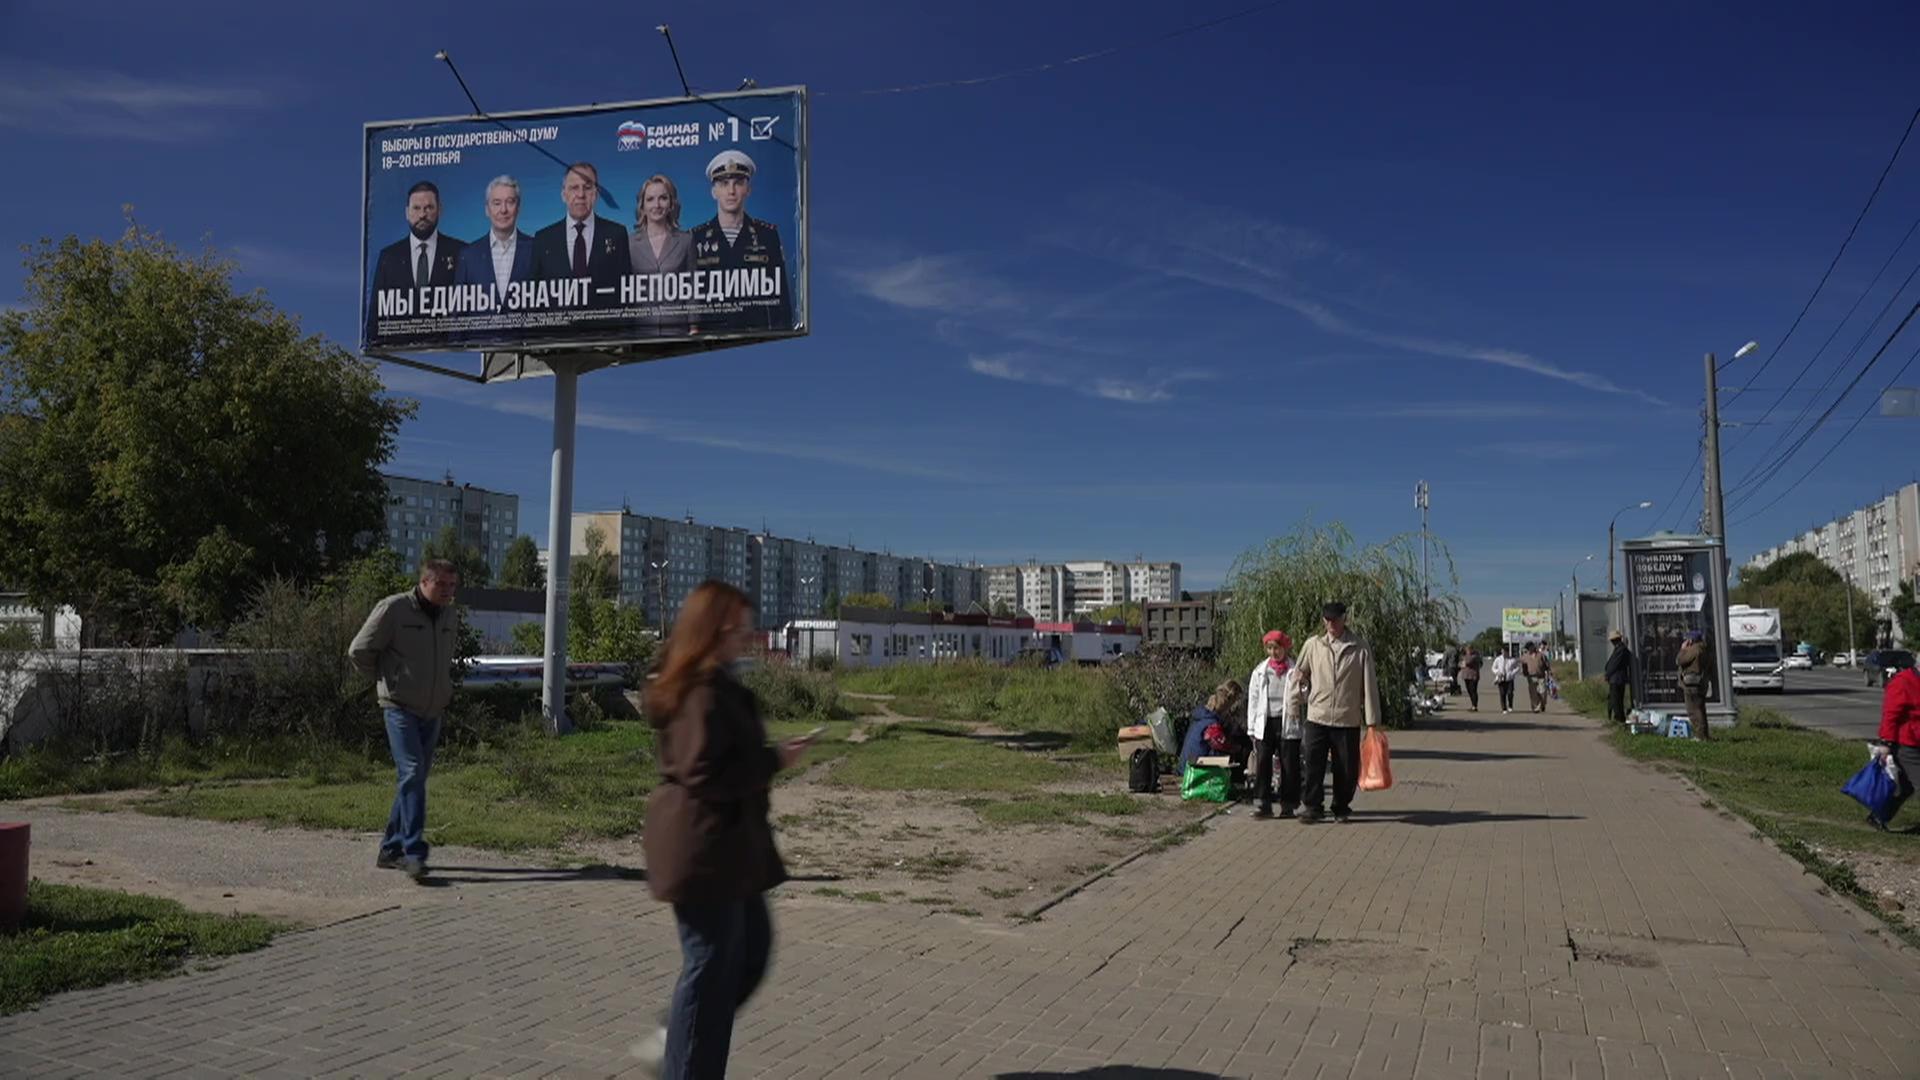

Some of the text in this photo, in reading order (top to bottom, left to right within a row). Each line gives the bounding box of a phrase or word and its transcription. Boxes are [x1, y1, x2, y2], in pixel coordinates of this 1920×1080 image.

[647, 123, 699, 137] ЕДИНАЯ
[727, 116, 739, 142] 1
[381, 126, 559, 153] ВЫБОРЫ В ГОСУДАРСТВЕННУЮ ДУМУ
[647, 135, 700, 149] РОССИЯ
[412, 151, 461, 168] СЕНТЯБРЯ
[377, 289, 414, 317] МЫ
[420, 283, 502, 315] ЕДИНЫ,
[508, 277, 592, 309] ЗНАЧИТ
[620, 267, 781, 304] НЕПОБЕДИМЫ
[1636, 563, 1672, 572] ПОБЕДУ
[1637, 574, 1683, 584] ПОДПИШИ
